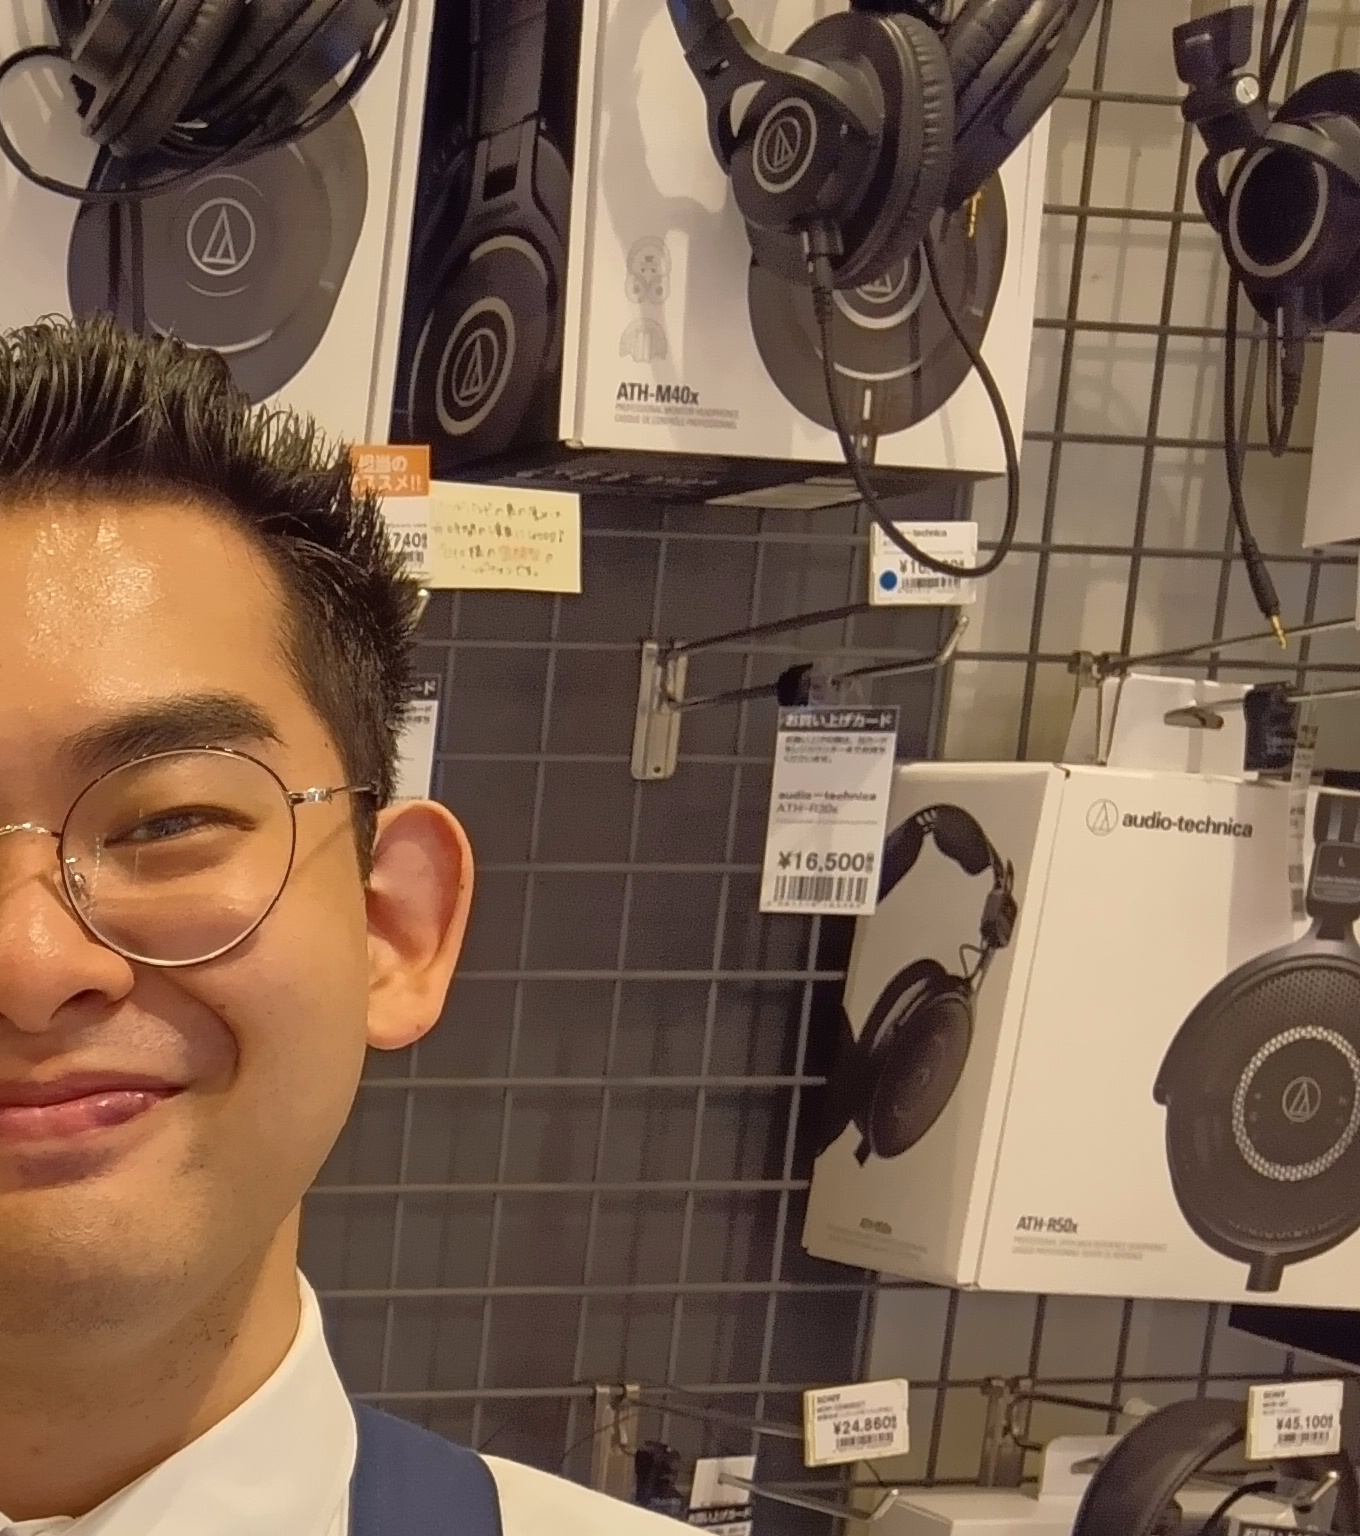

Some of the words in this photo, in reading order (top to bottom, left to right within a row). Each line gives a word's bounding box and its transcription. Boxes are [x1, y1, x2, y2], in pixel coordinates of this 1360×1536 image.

[616, 382, 700, 405] ATH-M40x
[1122, 810, 1254, 839] audio-technica
[776, 850, 866, 873] ¥16,500
